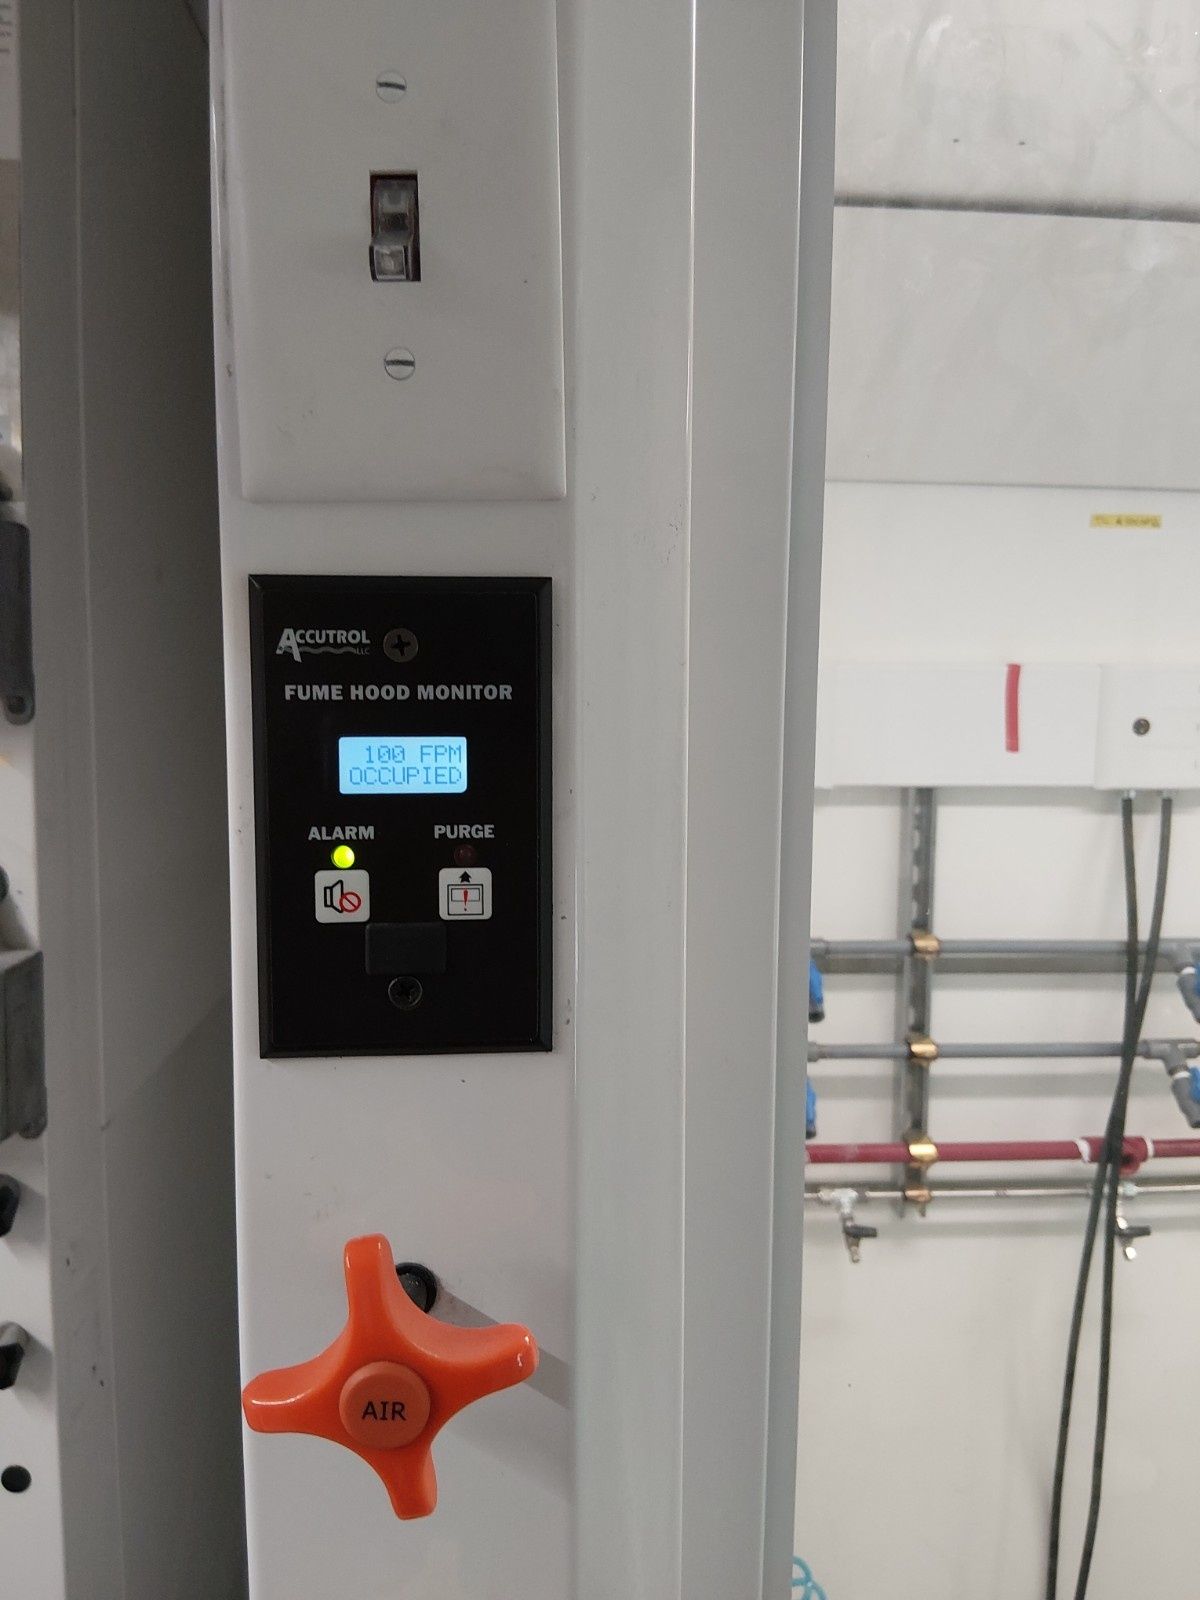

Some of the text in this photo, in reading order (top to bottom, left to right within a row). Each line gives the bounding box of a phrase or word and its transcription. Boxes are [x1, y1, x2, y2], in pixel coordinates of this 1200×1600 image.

[284, 684, 513, 701] FUME HOOD MONITOR
[365, 744, 462, 764] 100 FPM
[349, 766, 462, 786] OCCUPIED
[308, 825, 375, 841] ALARM
[434, 824, 495, 840] PURGE
[361, 1400, 407, 1421] AIR
